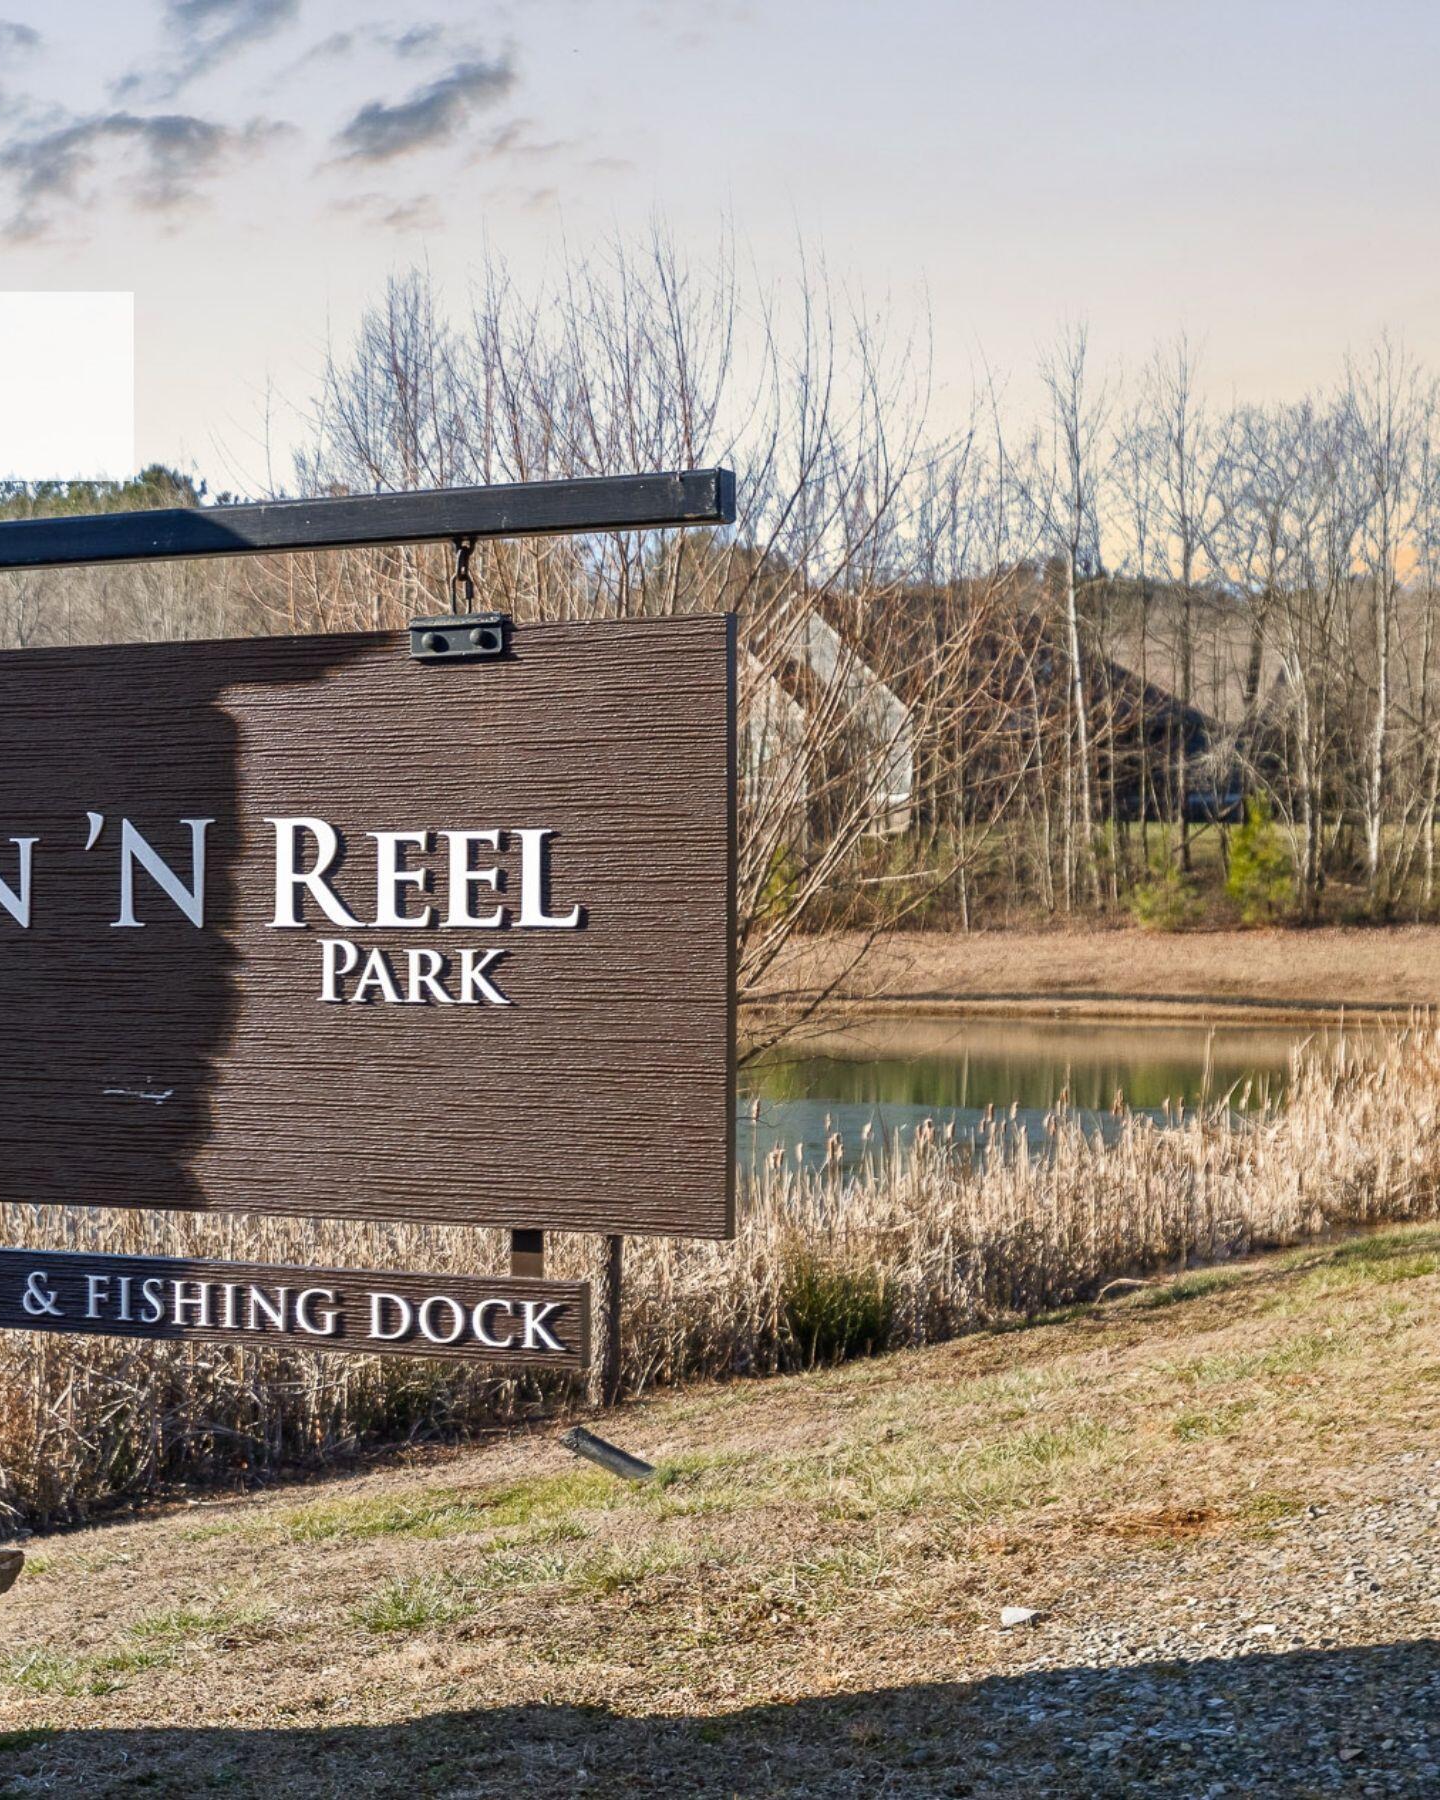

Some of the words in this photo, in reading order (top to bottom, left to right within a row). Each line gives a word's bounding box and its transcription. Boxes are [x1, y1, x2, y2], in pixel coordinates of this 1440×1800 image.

[263, 817, 582, 929] REEL
[316, 938, 511, 1005] PARK
[21, 1271, 62, 1316] &
[84, 1274, 341, 1336] FISHING
[366, 1292, 565, 1352] DOCK
